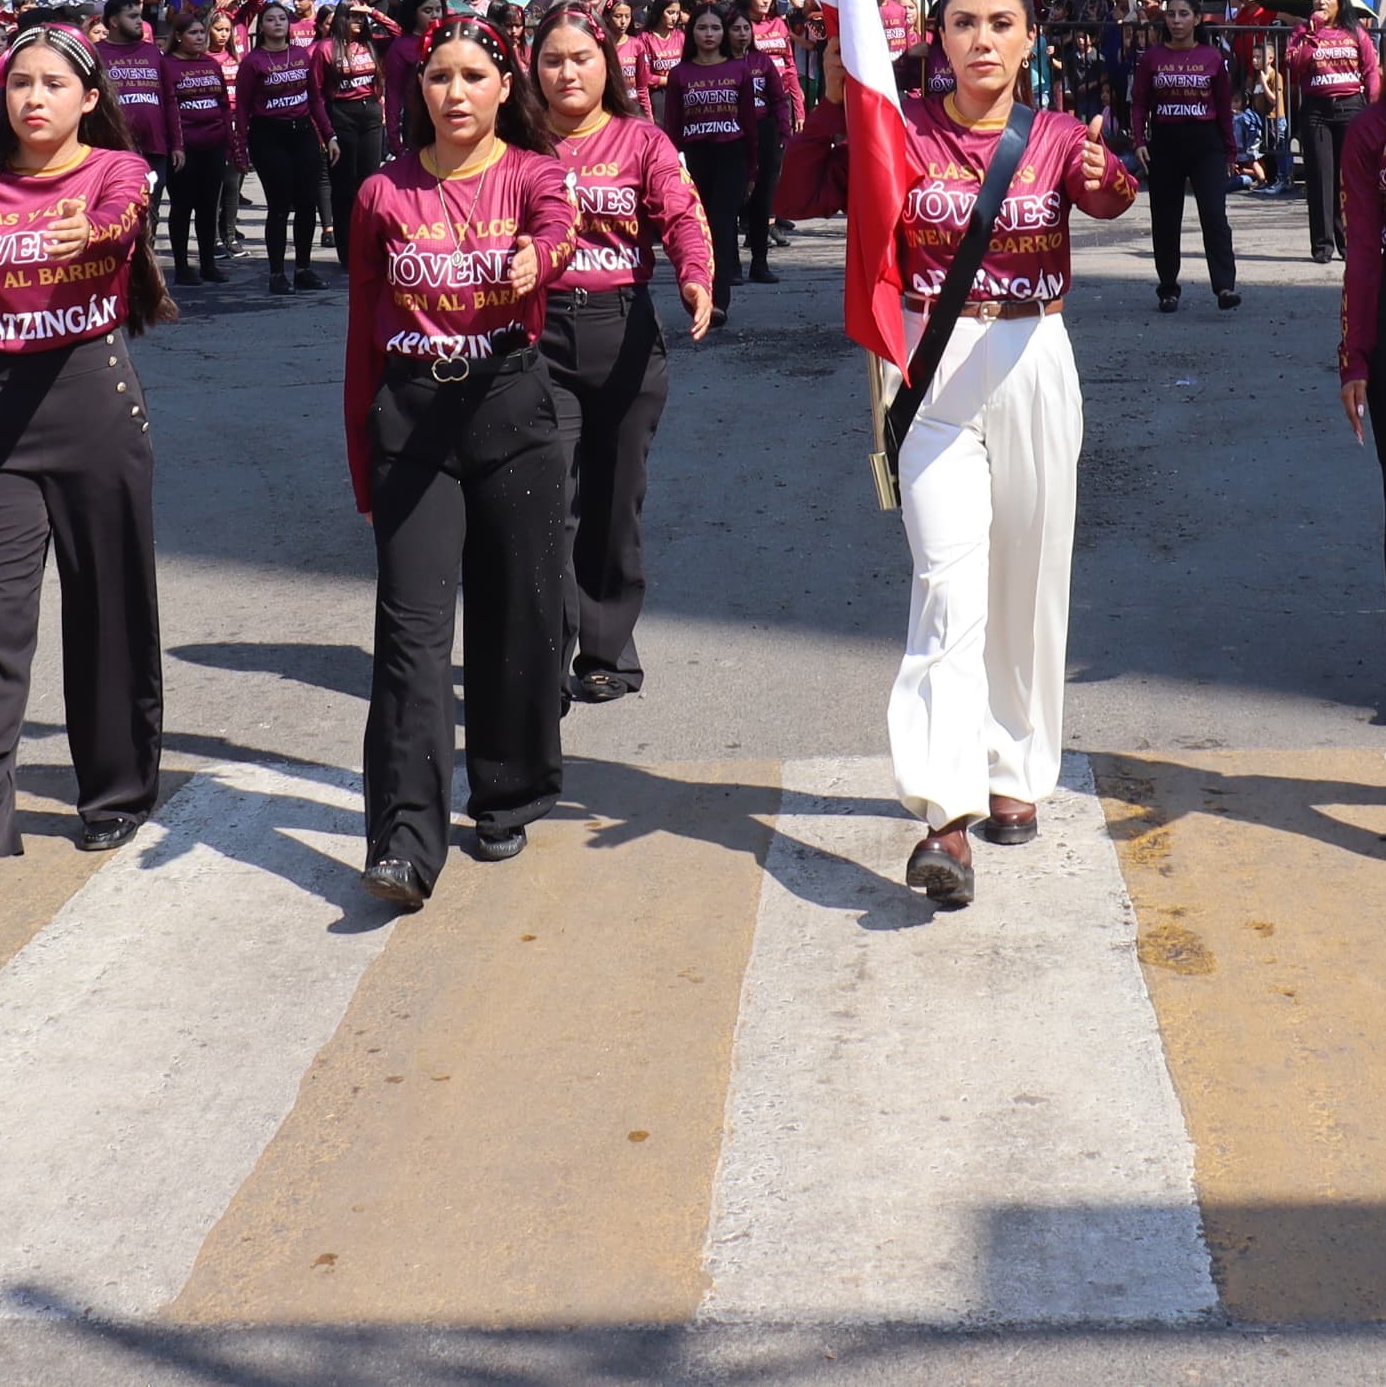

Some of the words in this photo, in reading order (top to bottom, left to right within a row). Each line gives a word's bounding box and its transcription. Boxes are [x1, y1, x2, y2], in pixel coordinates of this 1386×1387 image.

[108, 65, 158, 80] ÓVENES
[1158, 64, 1174, 72] LAS
[688, 80, 705, 89] LAS
[718, 78, 736, 86] LOS
[1157, 102, 1208, 116] PATZINGÁN
[683, 118, 740, 137] APATZINGÁ
[581, 162, 619, 177] LOS
[902, 181, 1061, 232] JÓVNES
[401, 222, 446, 240] LAS
[454, 223, 469, 241] Y
[476, 218, 518, 239] LOS
[4, 270, 31, 289] AL
[38, 256, 117, 285] BARRIO
[436, 293, 466, 311] AL
